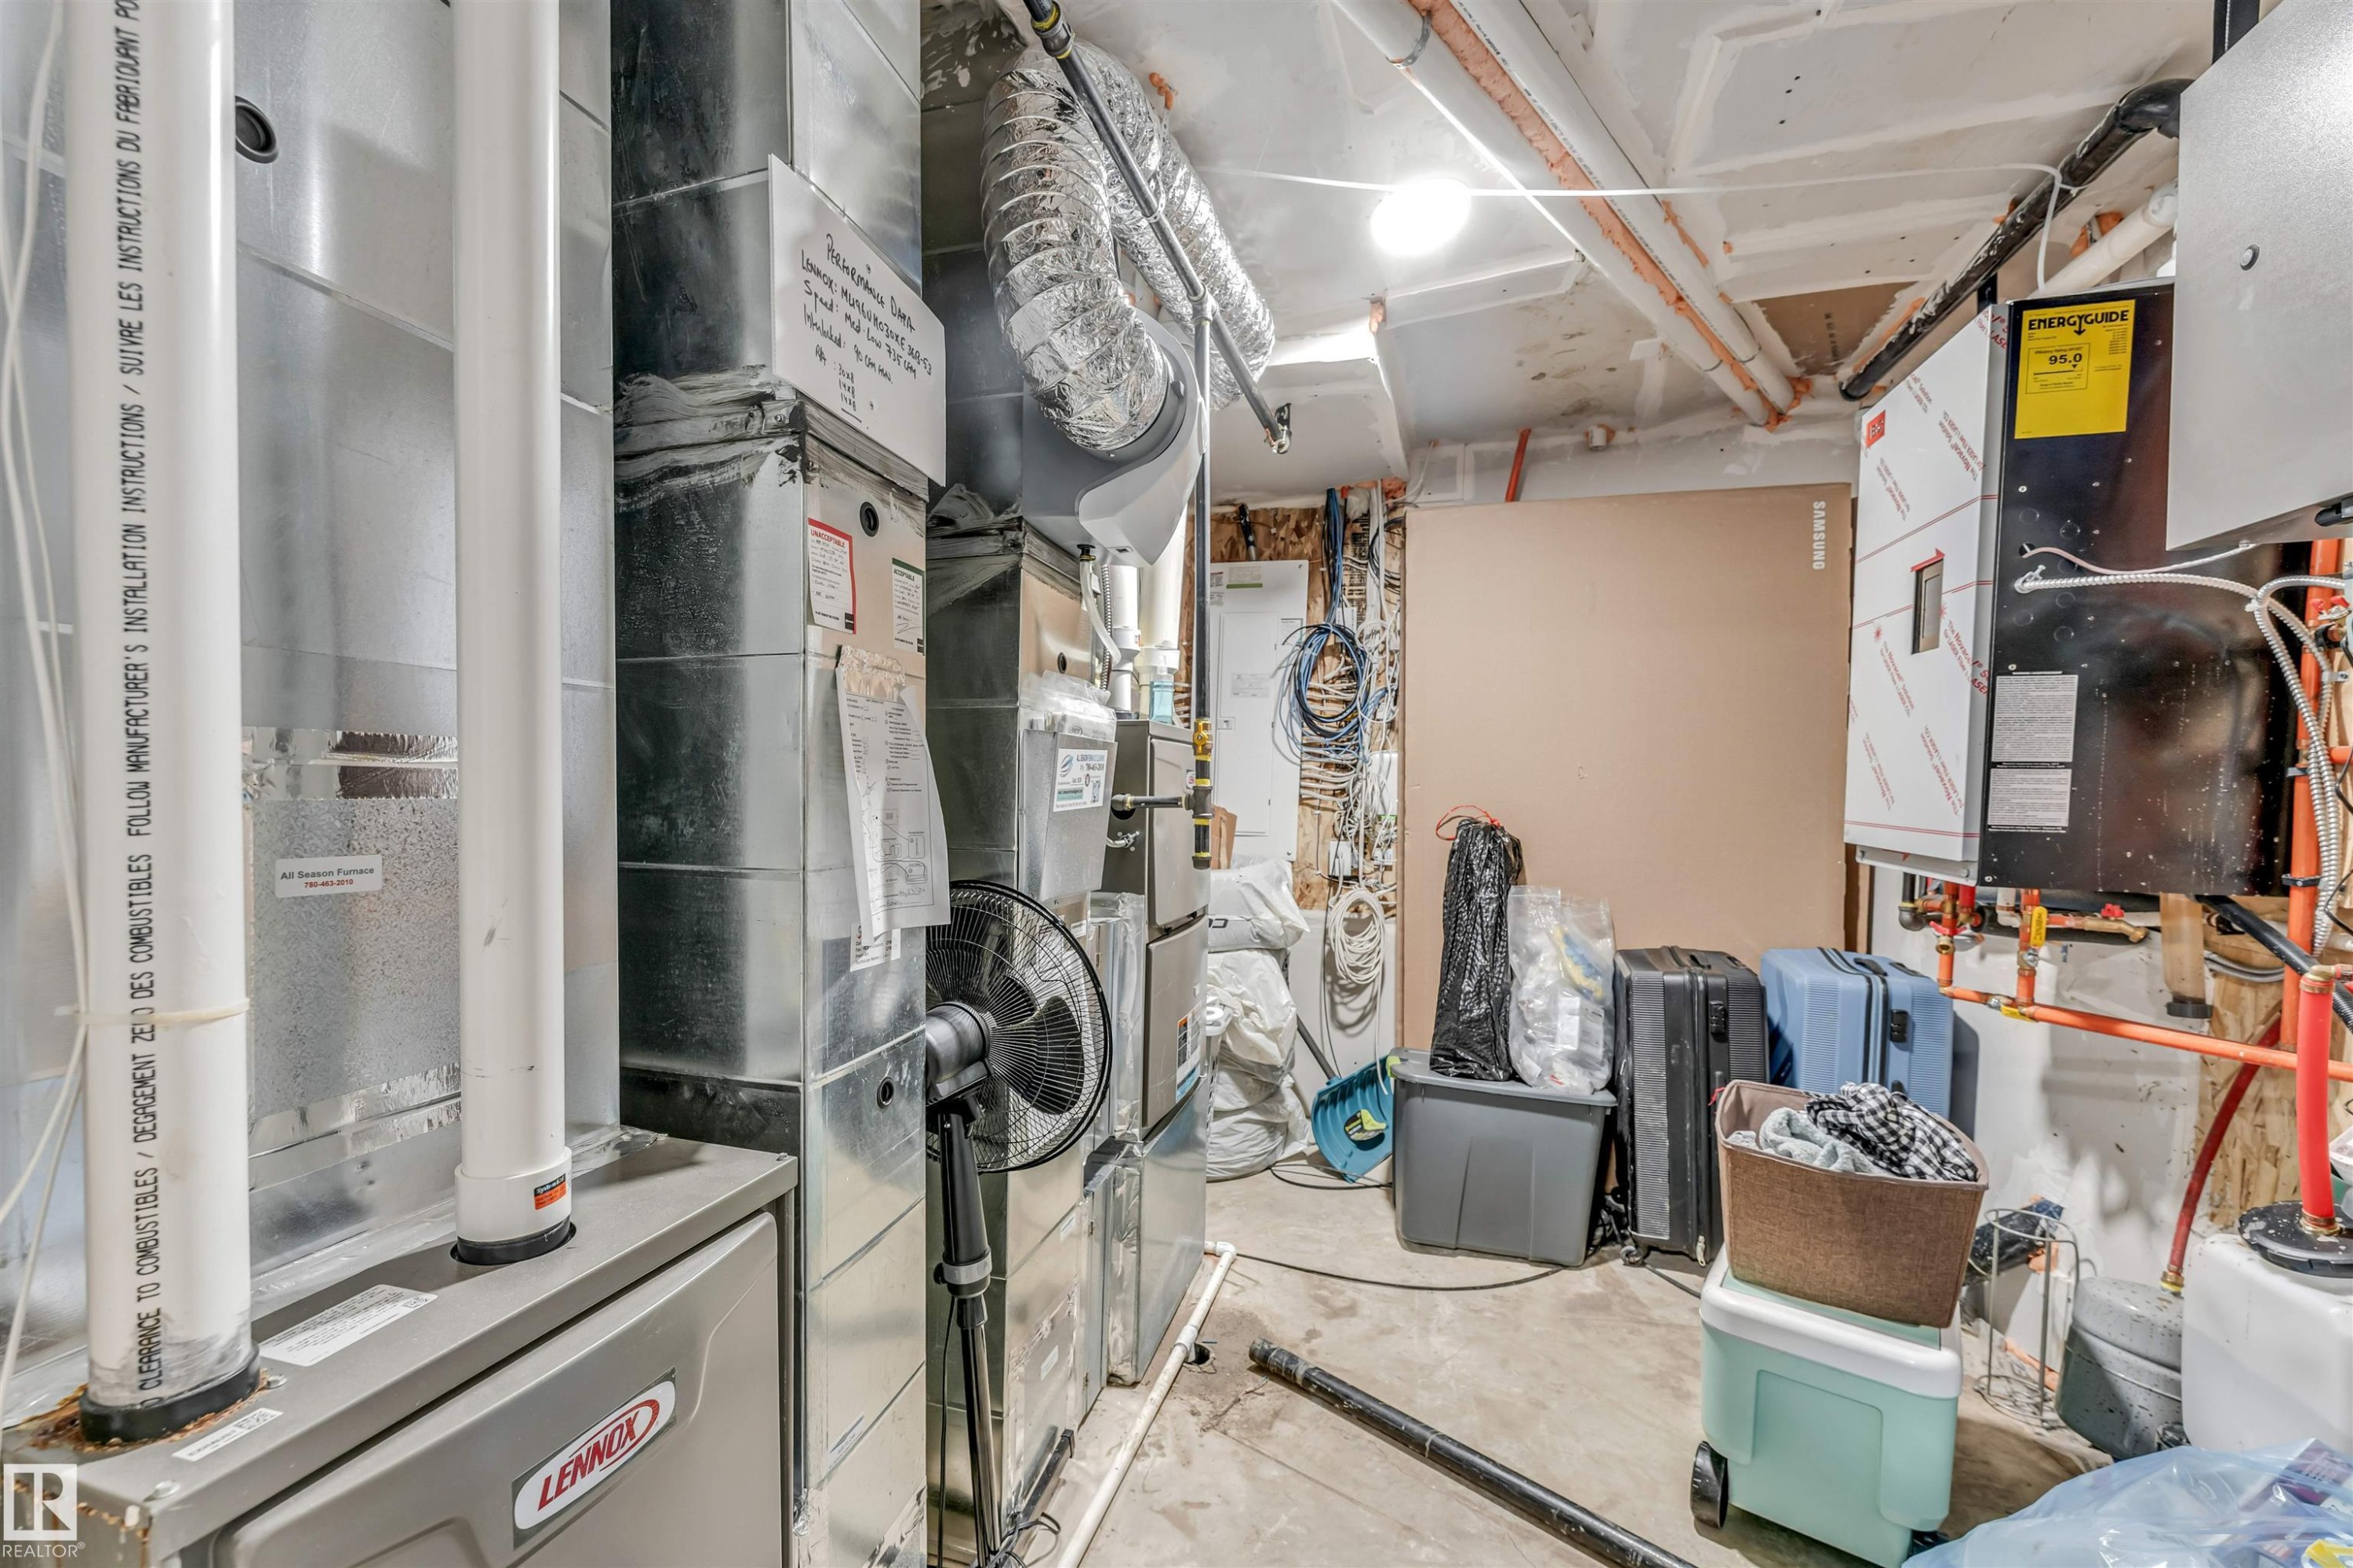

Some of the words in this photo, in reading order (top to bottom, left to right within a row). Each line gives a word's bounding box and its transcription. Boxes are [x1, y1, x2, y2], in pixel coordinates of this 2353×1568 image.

[115, 27, 141, 125] FABRIQUANT
[116, 129, 141, 153] DU
[117, 159, 142, 272] INSTRUCTIONS
[118, 282, 143, 311] LES
[827, 234, 885, 308] PERFORMANCE
[891, 296, 915, 333] DATA
[119, 318, 144, 376] SUIVRE
[2028, 310, 2129, 333] ENERGYGUIDE
[885, 342, 904, 366] 735
[2049, 353, 2082, 365] 95.0
[120, 403, 145, 513] INSTRUCTIONS
[811, 529, 845, 548] UNACCEPTABLE
[1813, 500, 1826, 569] SAMSUNG
[122, 524, 147, 633] INSTALLATION
[893, 569, 915, 581] ACCEPTABLE
[123, 644, 151, 772] MANUFACTURER'S
[127, 781, 151, 837] FOLLOW
[280, 871, 294, 880] All
[297, 869, 334, 879] Season
[336, 868, 374, 876] Furnace
[304, 879, 354, 888] 780-463-2010
[128, 853, 153, 963] COMBUSTIBLES
[130, 971, 154, 999] DES
[132, 1053, 157, 1144] DEGAGEMENT
[134, 1167, 160, 1276] COMBUSTIBLES
[137, 1282, 161, 1303] TO
[136, 1308, 163, 1391] CLEARANCE
[538, 1410, 640, 1512] LENNOX
